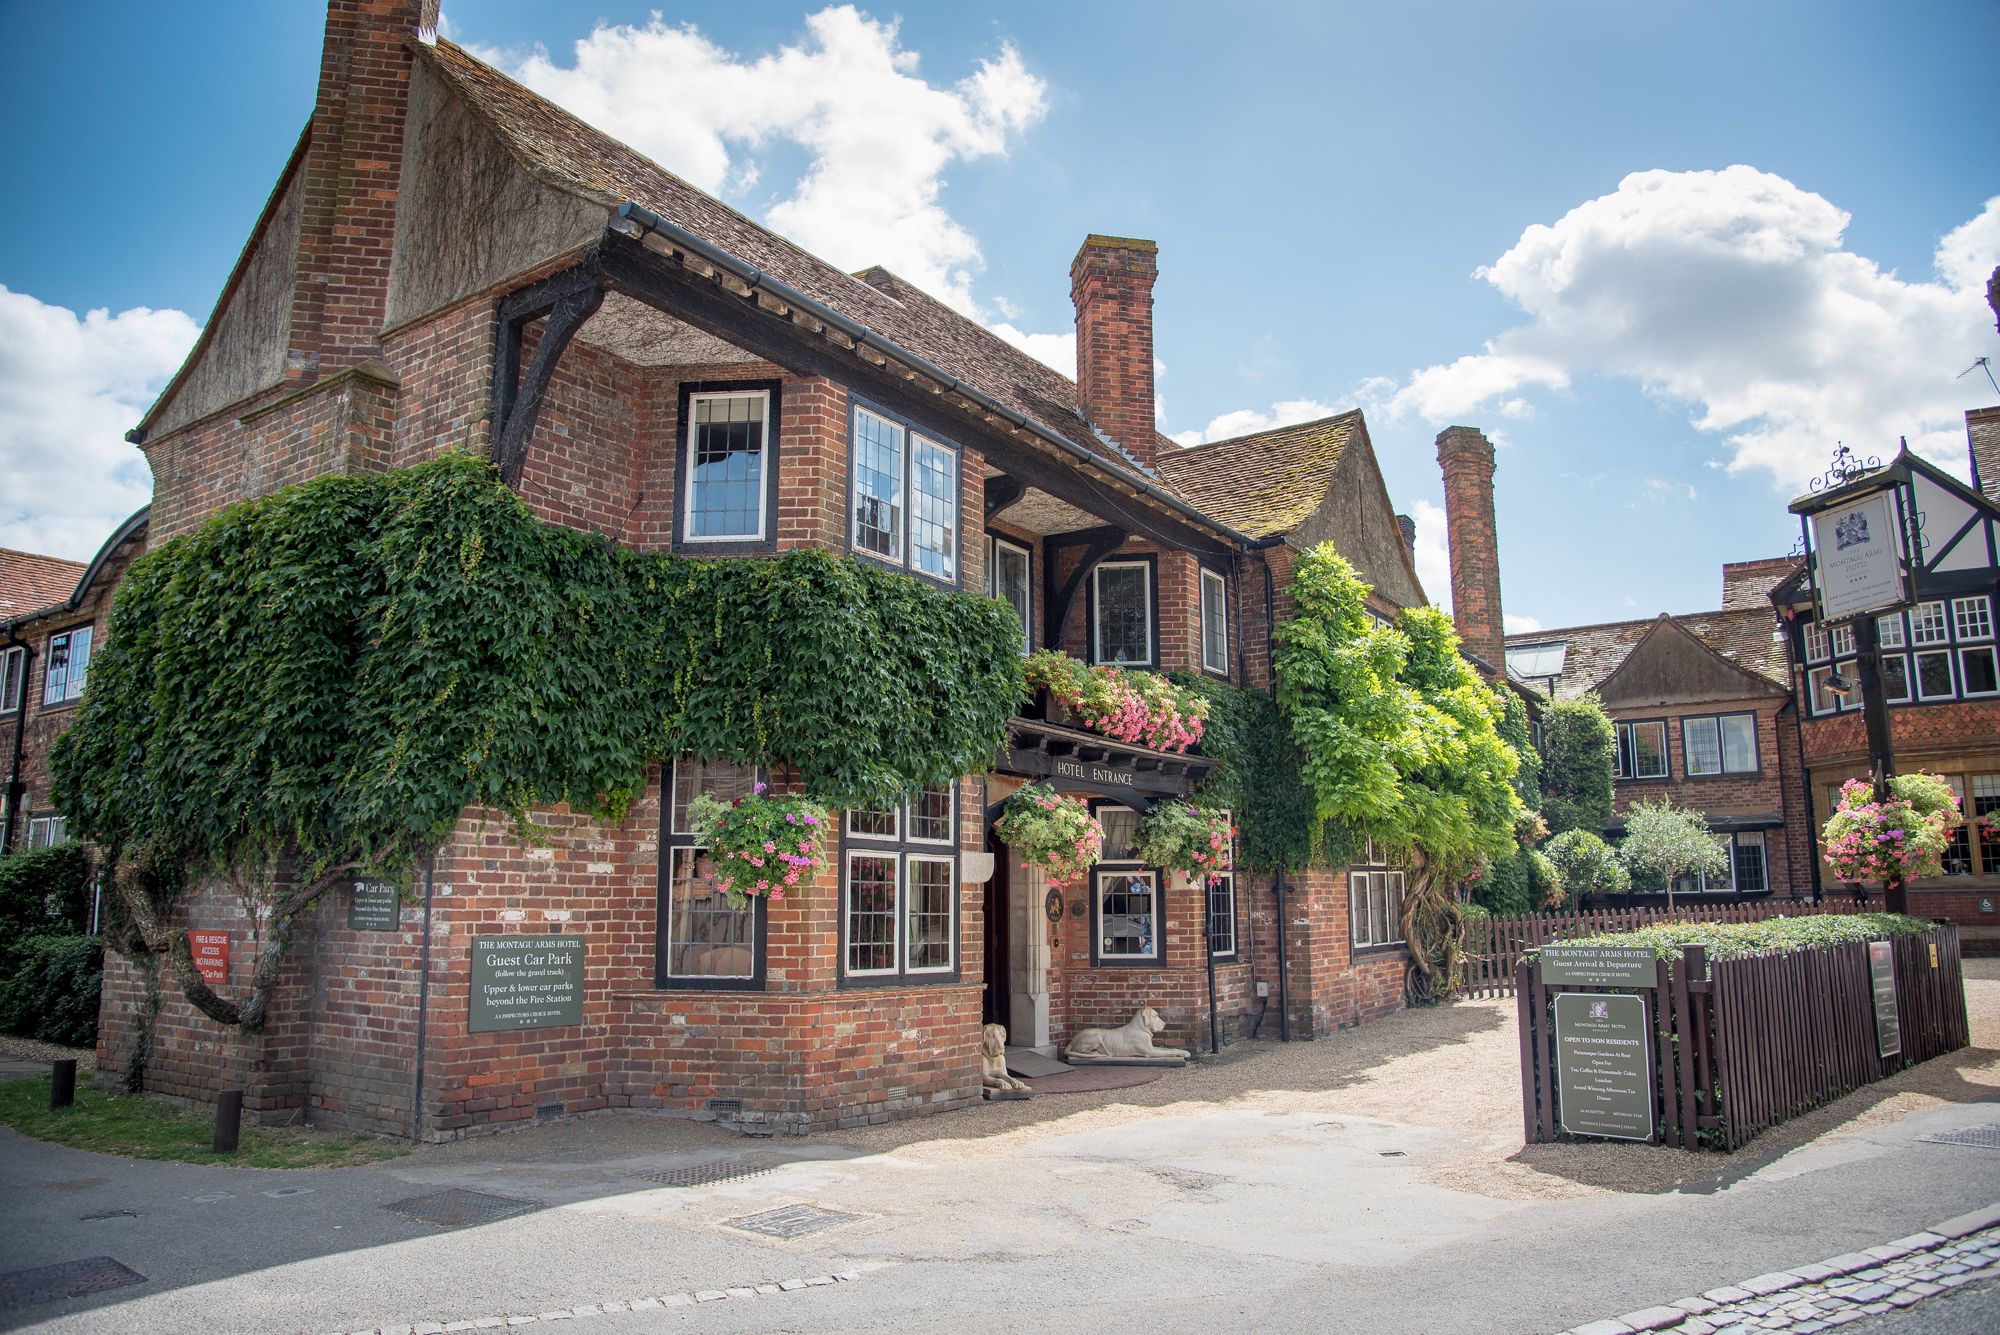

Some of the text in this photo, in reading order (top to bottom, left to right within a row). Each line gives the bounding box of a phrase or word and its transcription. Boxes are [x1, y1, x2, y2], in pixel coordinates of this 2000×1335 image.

[1830, 548, 1883, 568] MONTAGU ARMS
[1846, 561, 1868, 572] HOTEL
[1058, 762, 1132, 785] HOTEL ENTRANCE
[366, 883, 378, 892] Car
[209, 936, 227, 944] RESCUE
[479, 941, 495, 949] THE
[496, 941, 534, 949] MONTAGU
[201, 947, 220, 955] ACCESS
[204, 958, 224, 967] PARKING
[486, 952, 572, 966] Guest Car Park
[1606, 961, 1642, 969] Departure
[495, 969, 515, 978] (follow
[528, 969, 546, 977] gravel
[484, 985, 507, 995] Upper
[509, 984, 516, 992] &
[518, 983, 537, 992] lower
[553, 982, 573, 992] parks
[486, 997, 514, 1007] beyond
[546, 994, 572, 1002] Station
[1606, 1038, 1640, 1046] RESIDENTS
